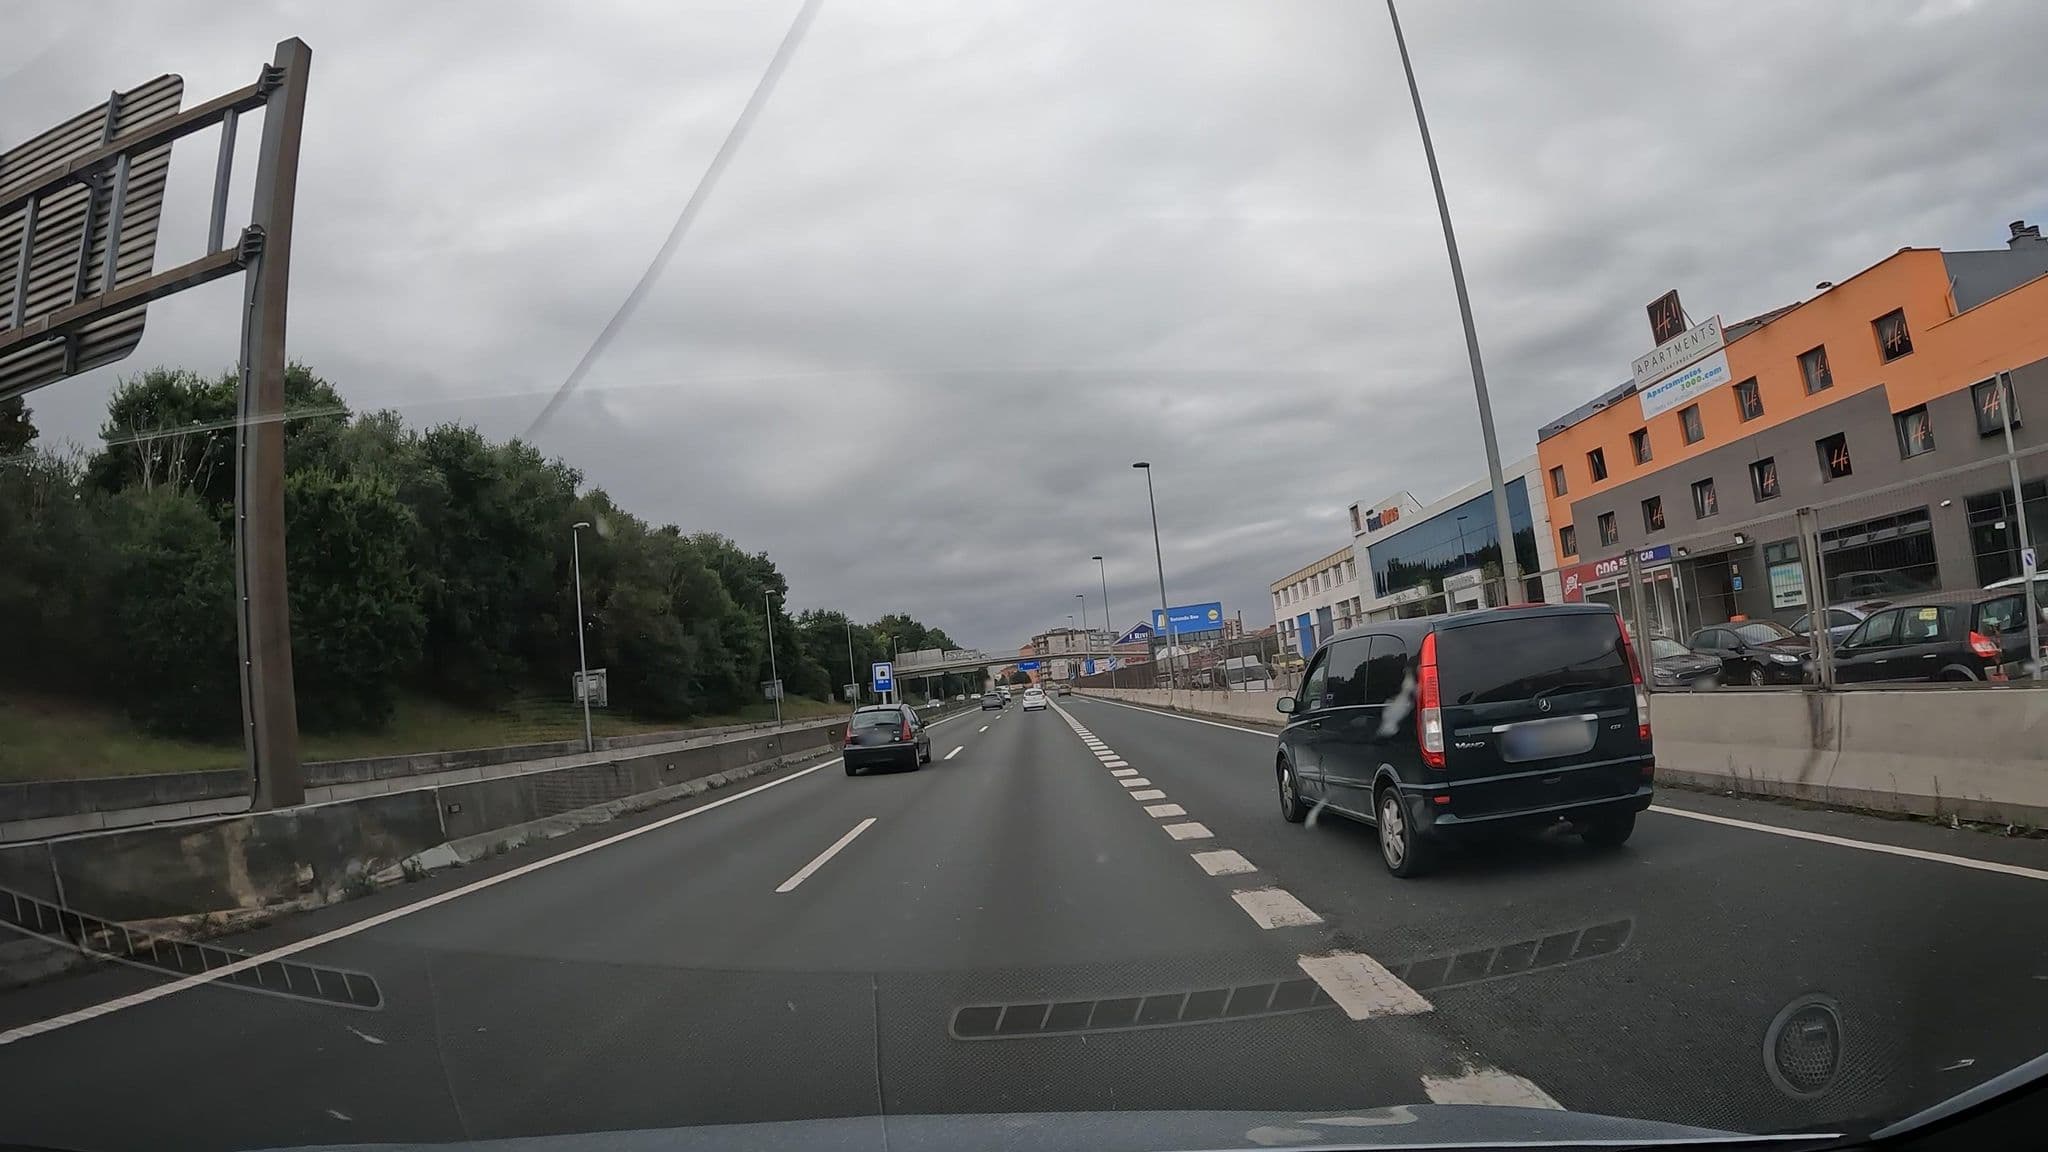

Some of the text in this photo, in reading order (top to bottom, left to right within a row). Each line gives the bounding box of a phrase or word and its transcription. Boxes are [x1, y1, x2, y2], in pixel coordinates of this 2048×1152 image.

[1636, 323, 1716, 376] APARTMENTS
[1646, 367, 1702, 400] Apartamentos
[1640, 550, 1654, 561] CAR
